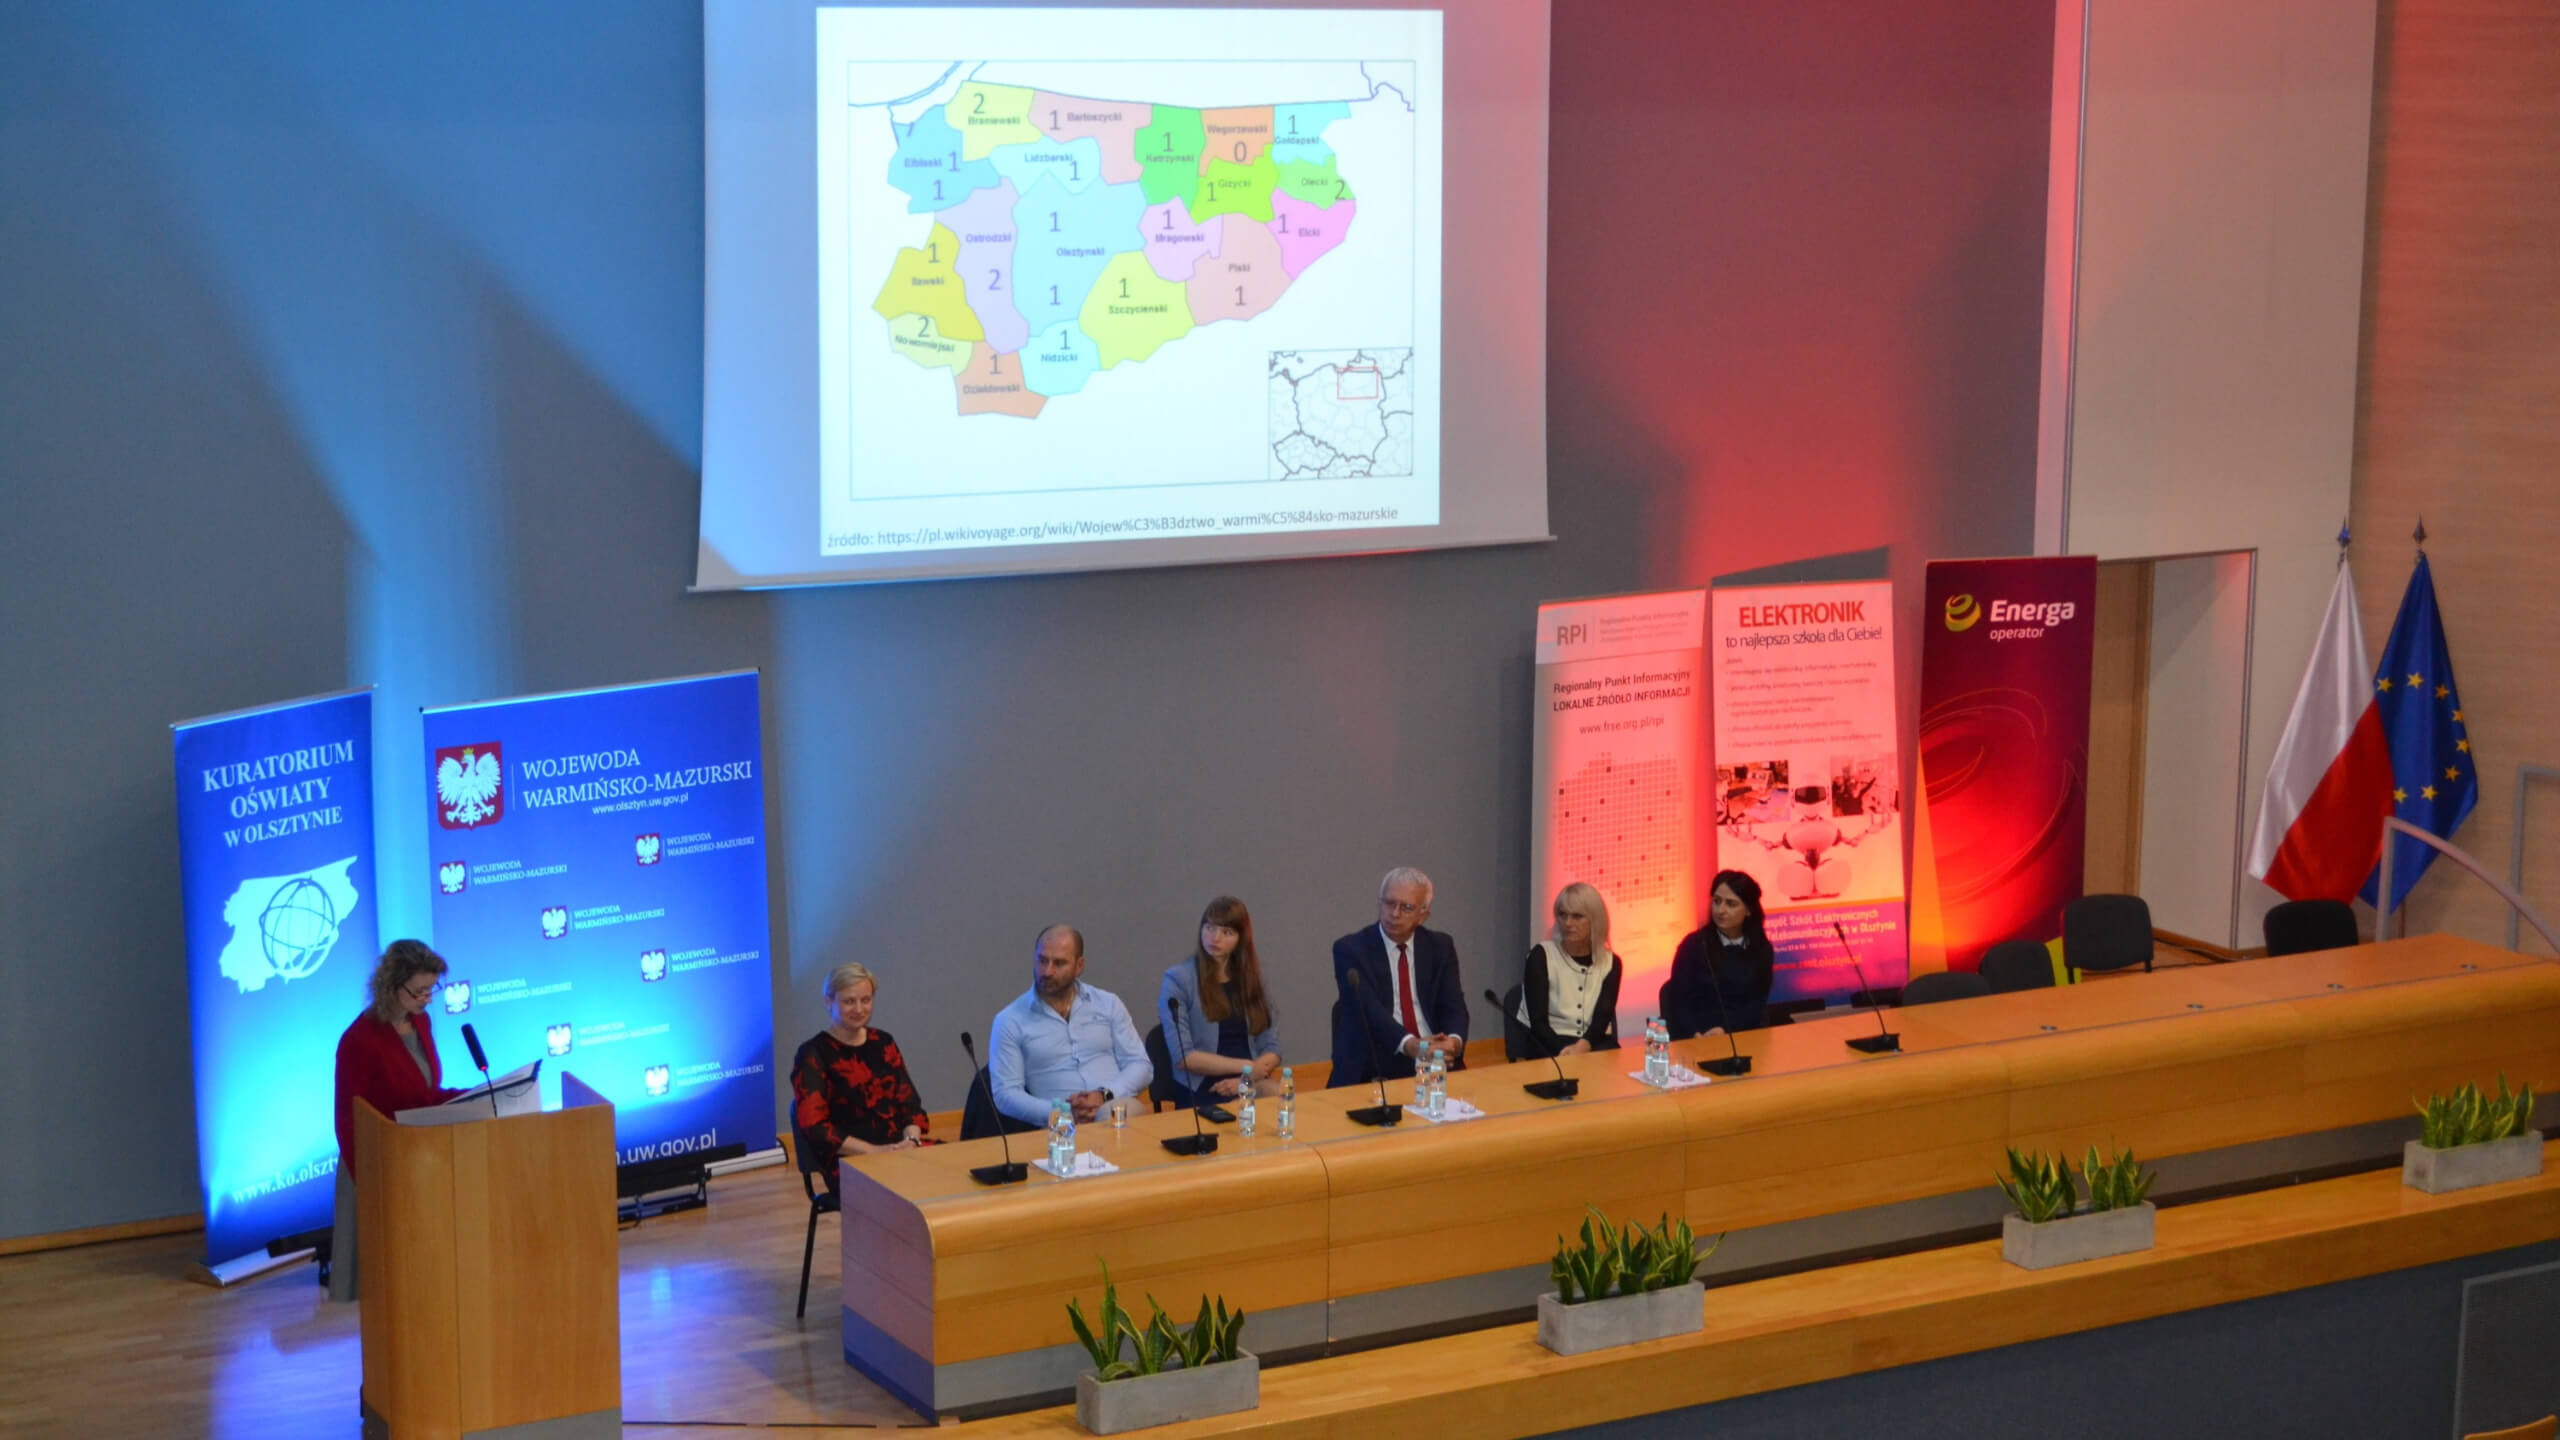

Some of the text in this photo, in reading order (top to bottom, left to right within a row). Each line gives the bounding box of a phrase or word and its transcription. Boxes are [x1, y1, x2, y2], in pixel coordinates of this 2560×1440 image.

[973, 93, 985, 114] 2
[1050, 110, 1061, 130] 1
[1289, 114, 1299, 135] 1
[1163, 132, 1174, 152] 1
[1234, 141, 1247, 162] 0
[948, 151, 960, 172] 1
[1070, 161, 1080, 181] 1
[933, 180, 944, 200] 1
[1207, 182, 1216, 202] 1
[1335, 179, 1346, 200] 2
[1050, 212, 1061, 232] 1
[1163, 209, 1174, 229] 1
[1279, 214, 1288, 233] 1
[928, 243, 940, 263] 1
[989, 269, 1001, 290] 2
[1119, 278, 1130, 298] 1
[1050, 285, 1061, 306] 1
[1235, 286, 1246, 306] 1
[918, 316, 930, 337] 2
[1060, 330, 1071, 350] 1
[989, 354, 1002, 374] 1
[827, 533, 874, 548] źródło:
[1739, 601, 1865, 628] ELEKTRONIK
[1990, 600, 2076, 627] Energa
[1556, 623, 1587, 646] RPI
[1726, 626, 1882, 650] to najlepsza szkoła dla Ciebie!
[1990, 627, 2044, 642] operator
[1553, 670, 1690, 694] Regionalny Punkt Informacyjny
[1553, 697, 1594, 712] LOKALNE
[1634, 687, 1691, 701] INFORMACJI
[203, 740, 354, 792] KURATORIUM
[522, 748, 640, 780] WOJEWODA
[523, 760, 753, 808] WARMIŃSKO-MAZURSKI
[231, 776, 331, 819] OŚWIATY
[592, 792, 689, 815] www.olsztyn.uw.gov.pl
[224, 806, 343, 848] W OLSZTYNIE
[667, 832, 711, 846] WOJEWODA
[473, 860, 521, 873] WOJEWODA
[574, 904, 620, 918] WOJEWODA
[671, 947, 716, 961] WOJEWODA
